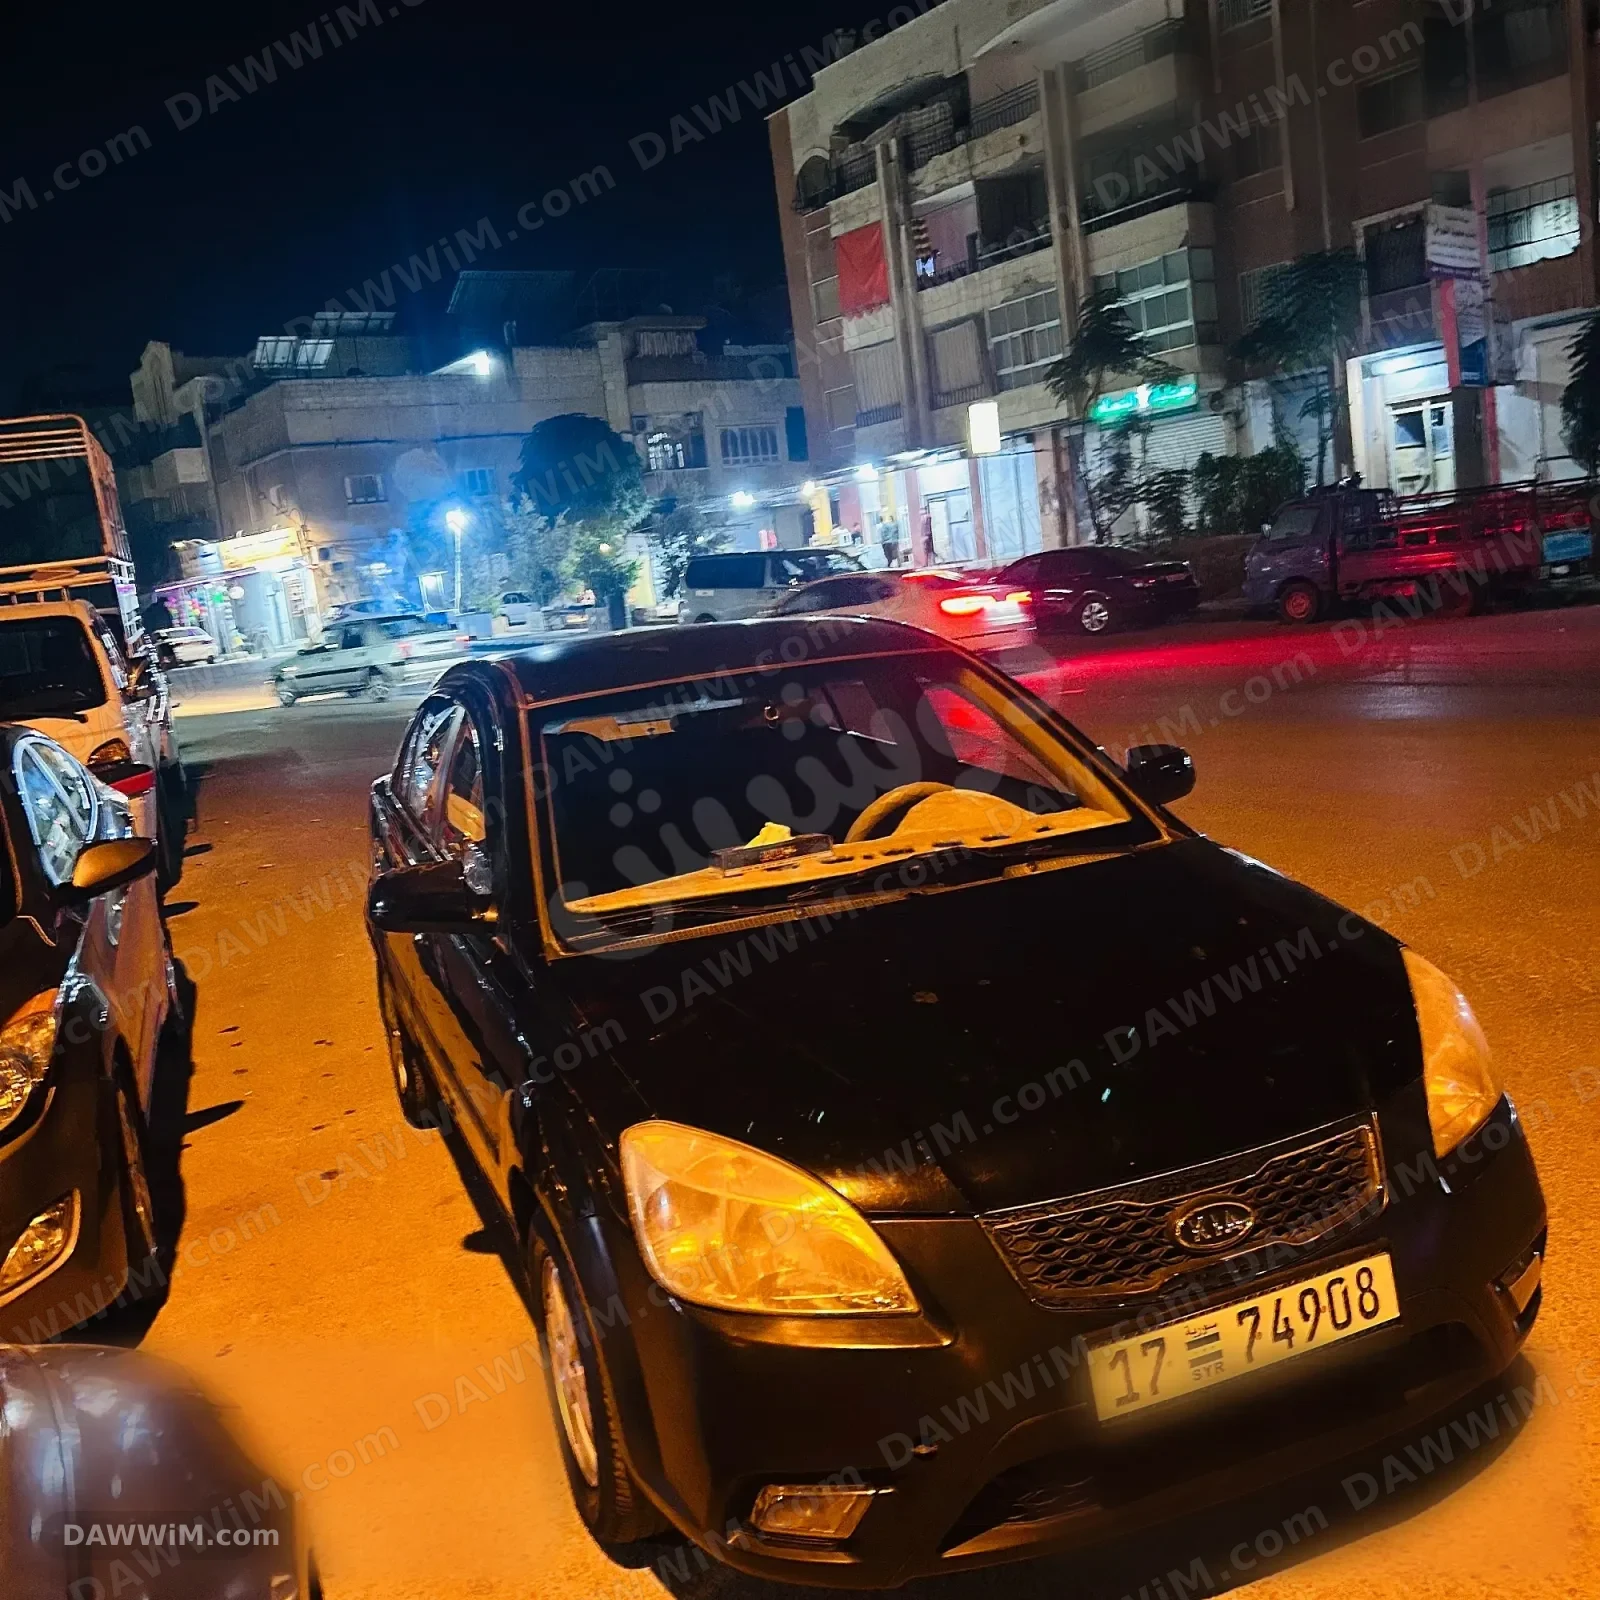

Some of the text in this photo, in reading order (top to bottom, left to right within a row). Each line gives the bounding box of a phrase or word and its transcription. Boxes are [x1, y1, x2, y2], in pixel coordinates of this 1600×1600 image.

[1190, 1210, 1246, 1242] KIA
[1108, 1267, 1380, 1408] 17 74908
[1191, 1361, 1225, 1381] SYR
